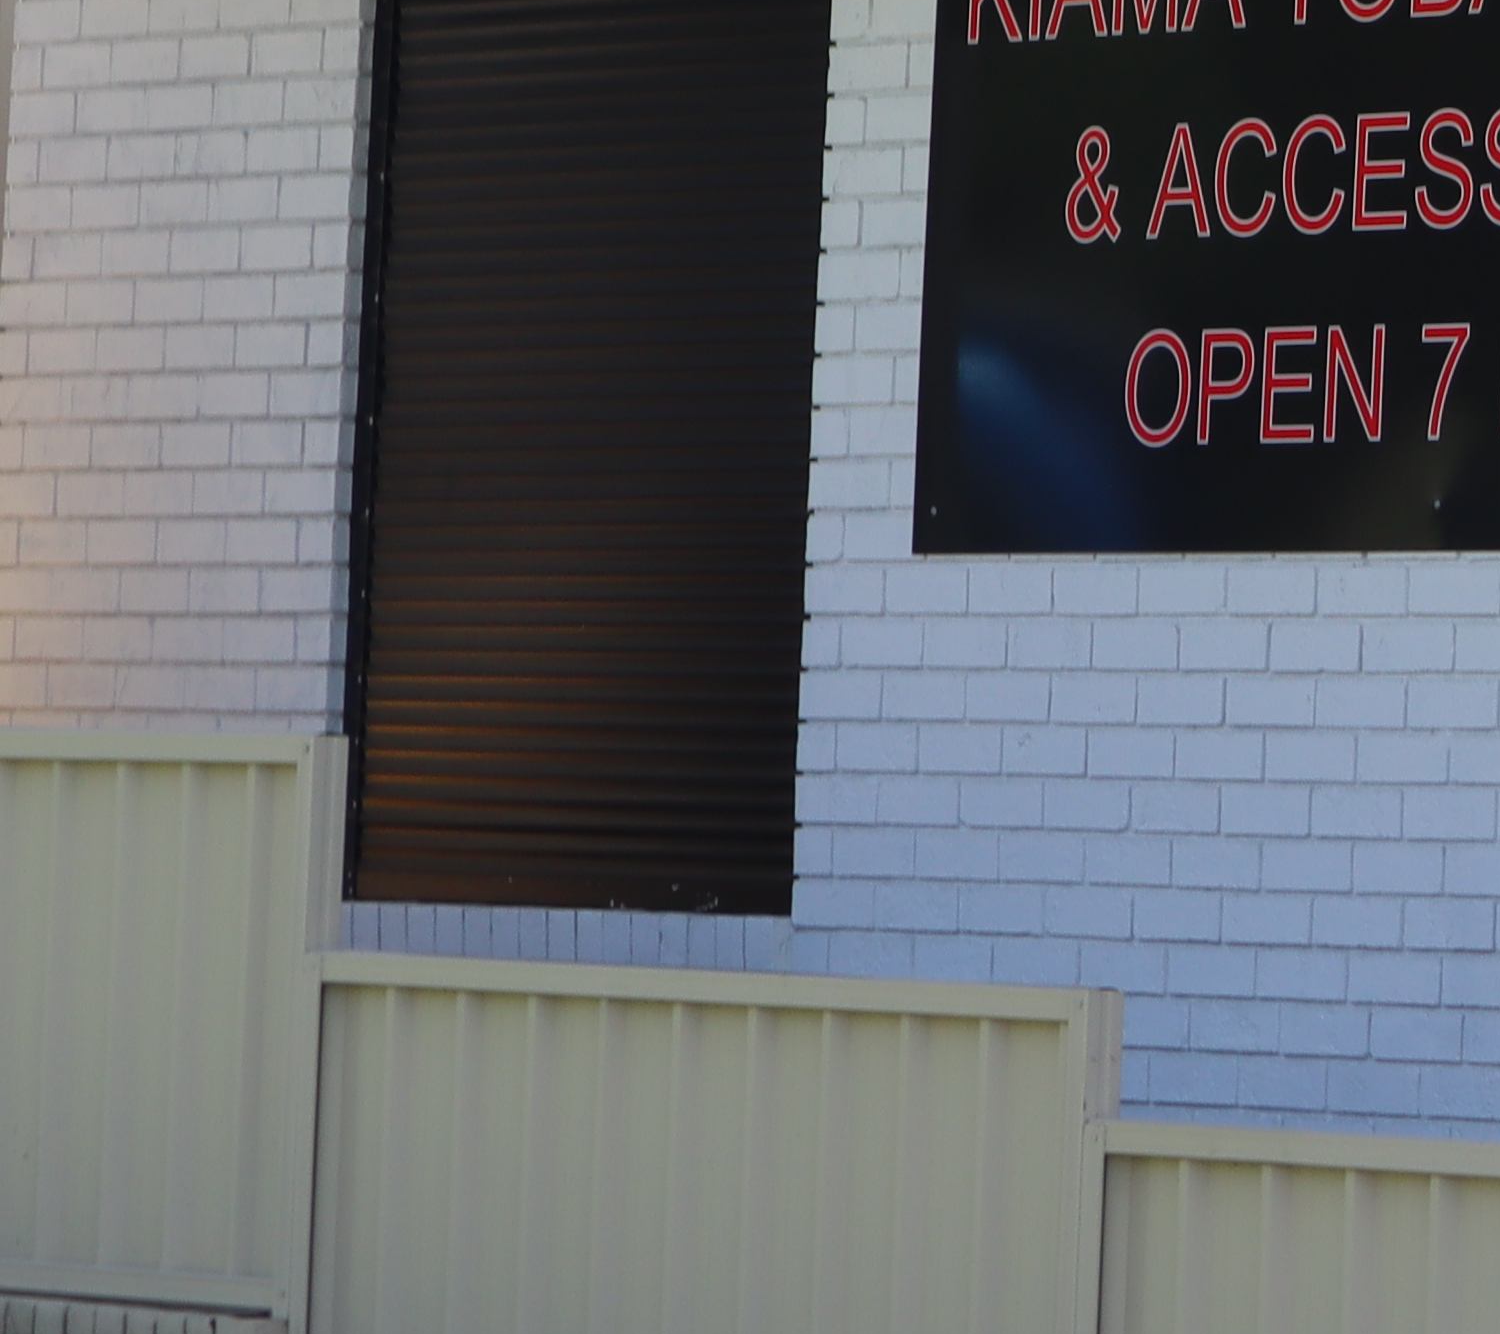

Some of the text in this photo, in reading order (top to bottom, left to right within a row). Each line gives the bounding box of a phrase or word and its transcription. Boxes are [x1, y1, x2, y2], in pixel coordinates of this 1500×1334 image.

[1065, 125, 1121, 244] &
[1124, 324, 1386, 448] OPEN
[1421, 323, 1471, 441] 7
